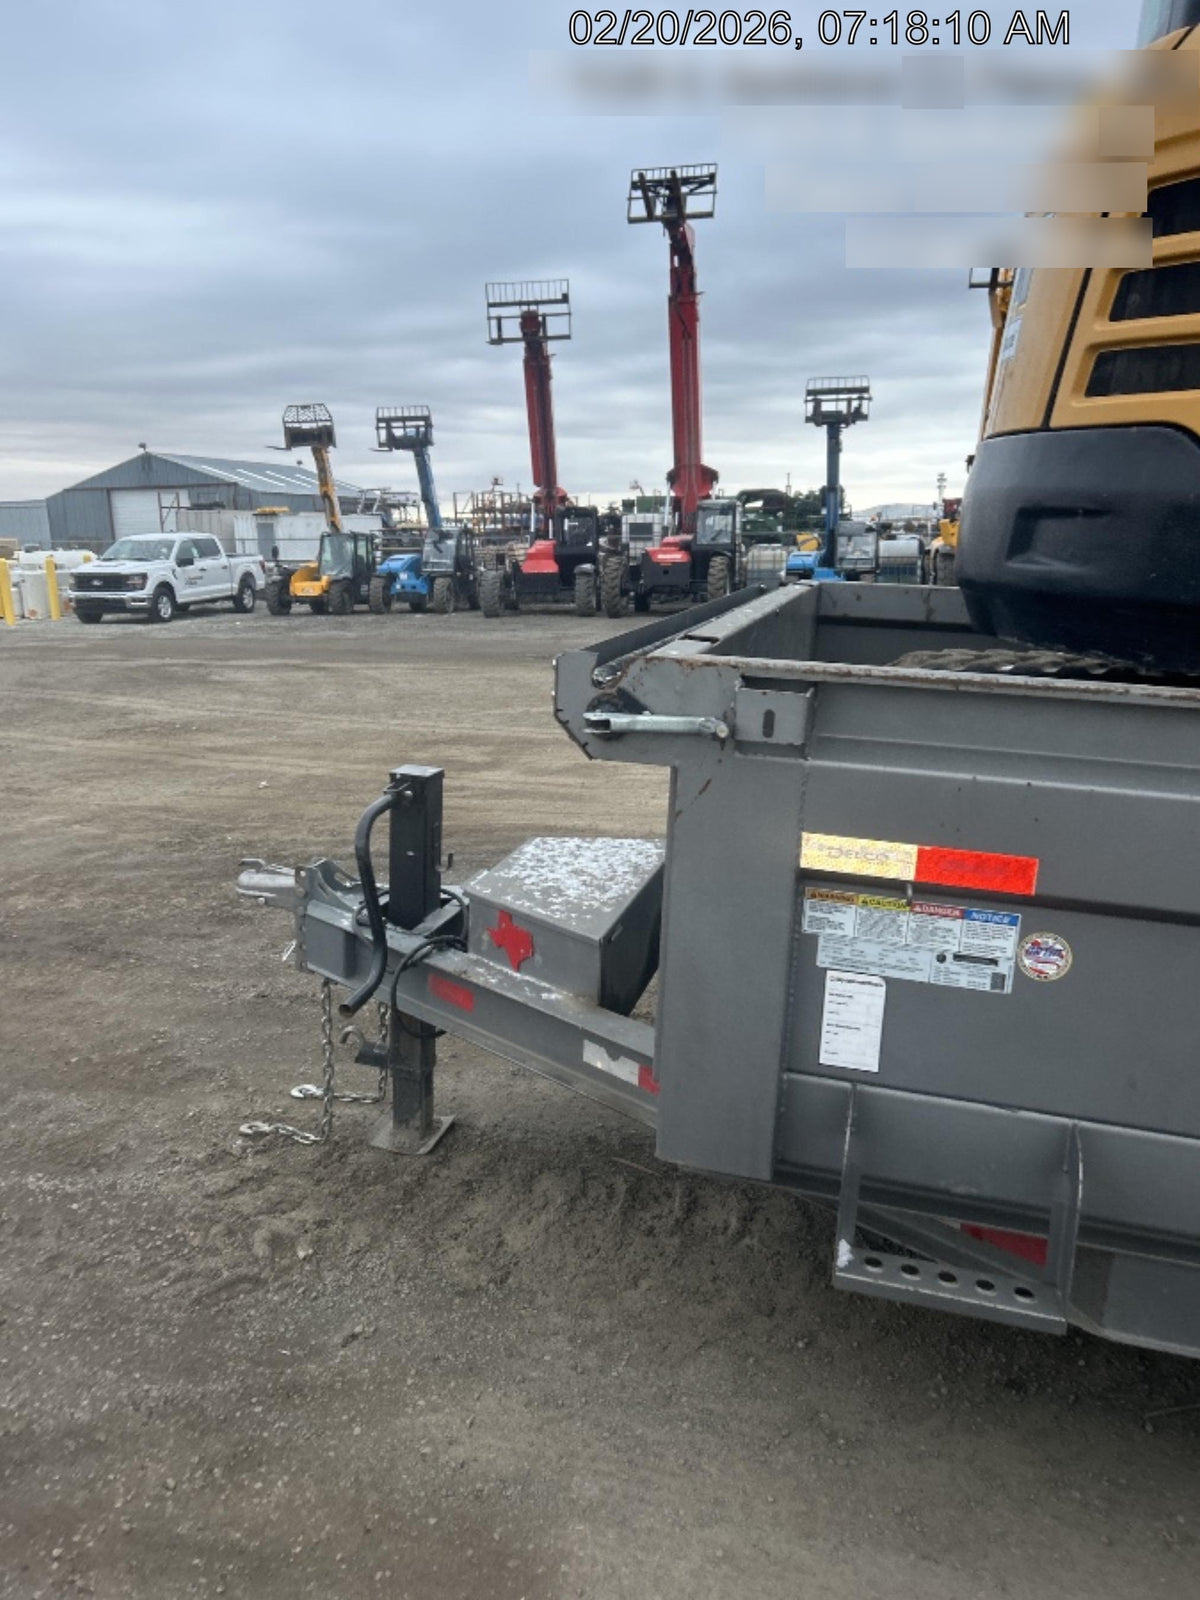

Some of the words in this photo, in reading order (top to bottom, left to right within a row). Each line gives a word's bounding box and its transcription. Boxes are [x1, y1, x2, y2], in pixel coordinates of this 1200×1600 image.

[816, 891, 855, 904] WARNING
[869, 899, 908, 910] CAUTION
[921, 904, 961, 917] DANGER
[970, 911, 1011, 925] NOTICE
